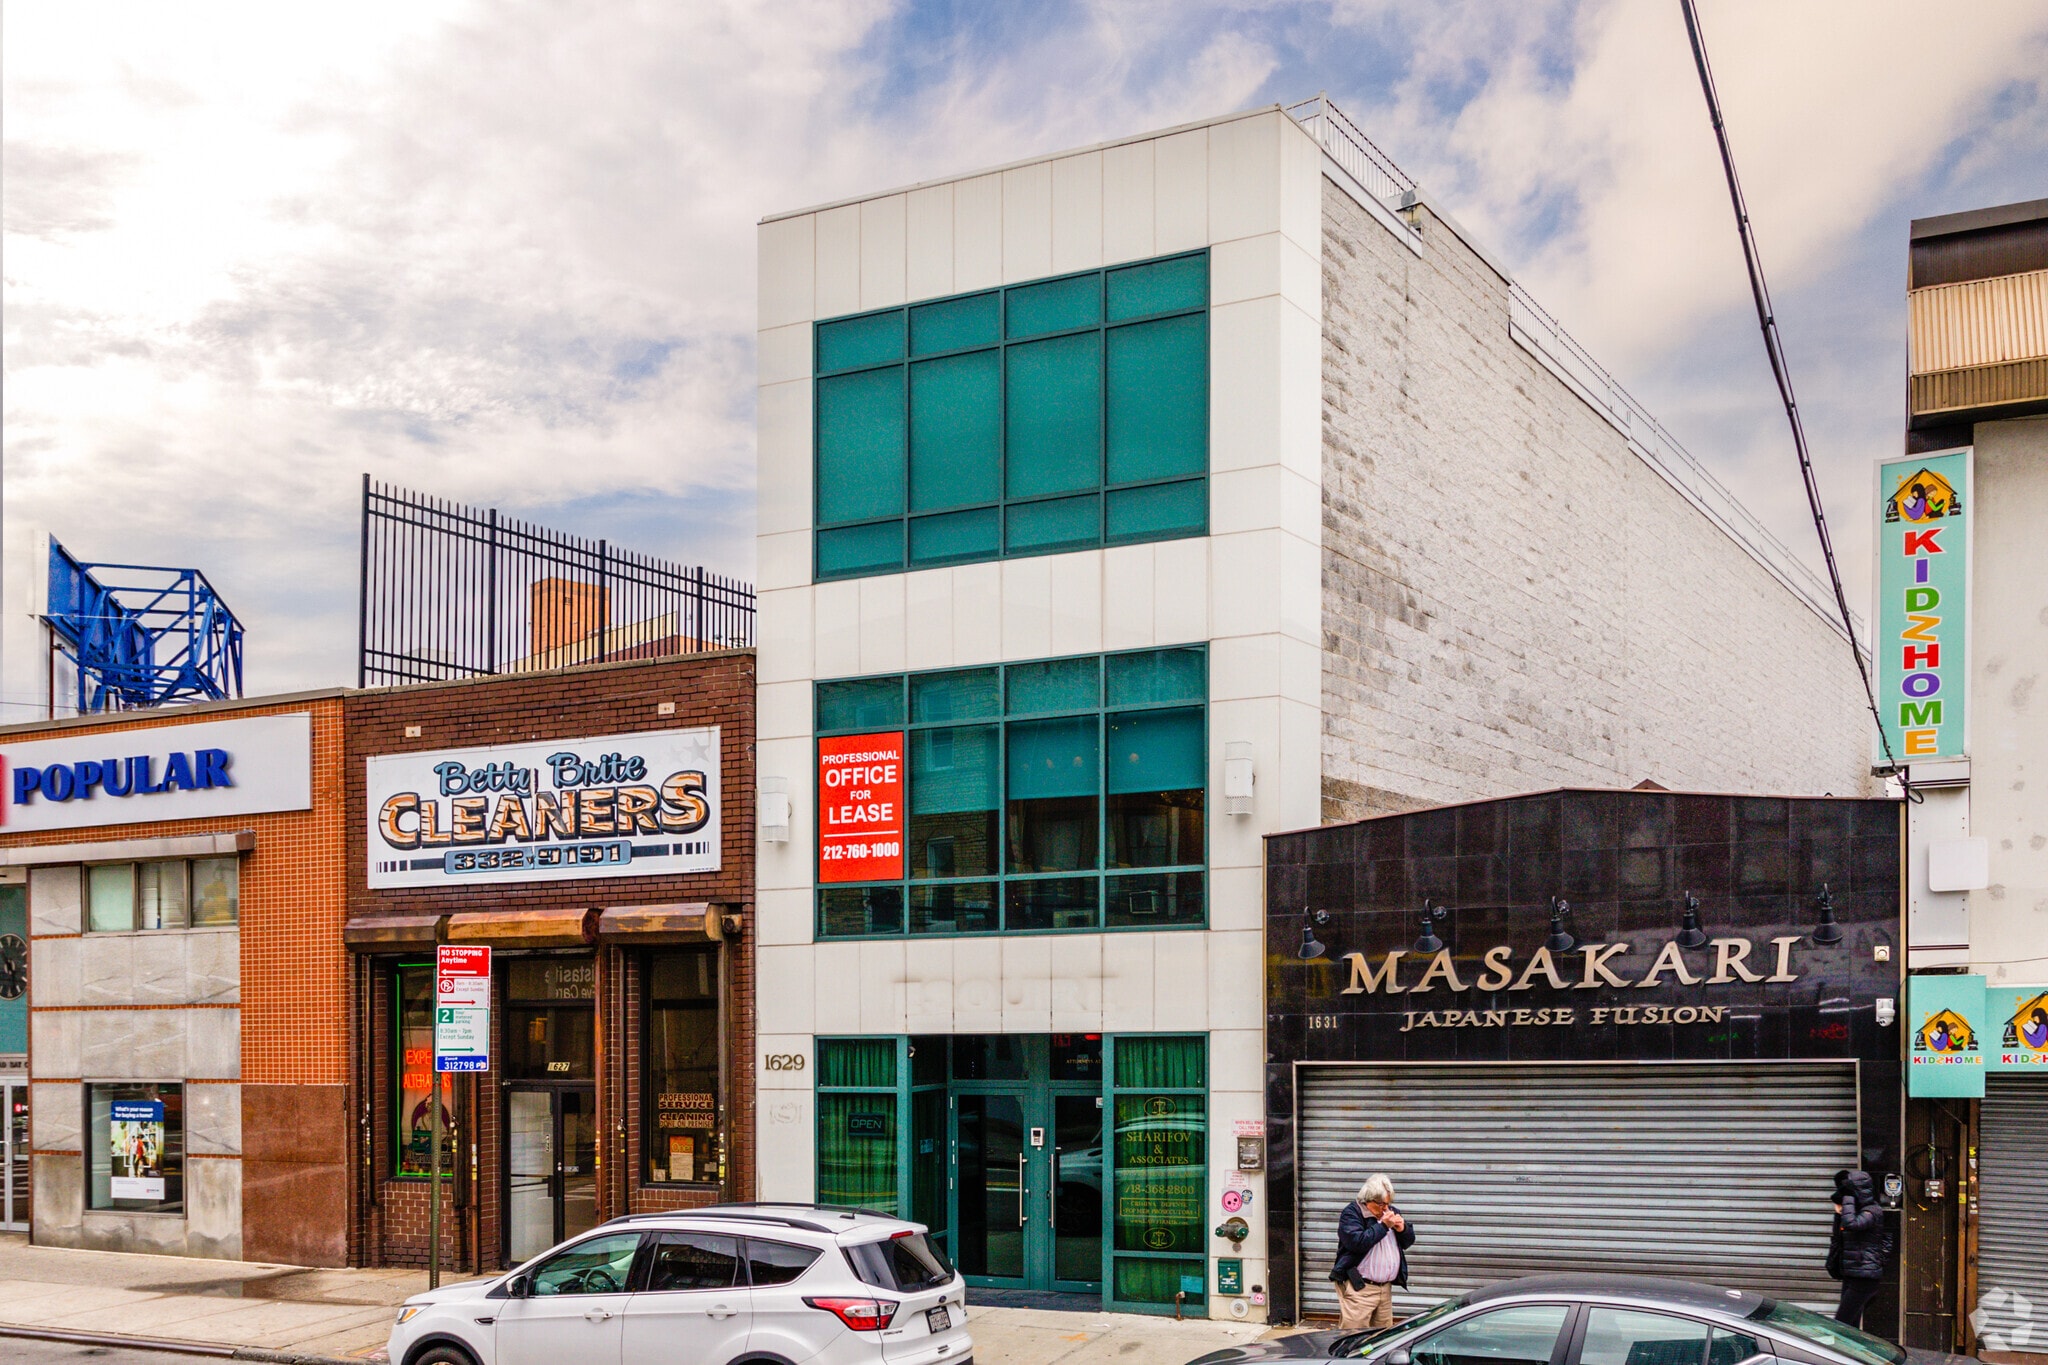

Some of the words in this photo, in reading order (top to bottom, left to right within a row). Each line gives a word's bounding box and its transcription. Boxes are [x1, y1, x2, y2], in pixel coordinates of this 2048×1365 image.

[1900, 528, 1944, 755] KIDZHOME
[822, 750, 899, 765] PROFESSIONAL
[13, 748, 233, 805] POPULAR
[434, 761, 537, 797] Betty
[546, 752, 648, 789] Brite
[825, 765, 897, 787] OFFICE
[850, 790, 871, 800] FOR
[378, 770, 710, 851] CLEANERS
[829, 803, 893, 825] LEASE
[823, 842, 899, 860] 212-760-1000
[441, 949, 450, 957] NO
[451, 949, 483, 957] STOPPING
[441, 957, 468, 965] Anytime
[1341, 935, 1802, 996] MASAKARI
[441, 1009, 450, 1022] 2
[1309, 1015, 1337, 1029] 1631
[1400, 1007, 1575, 1032] JAPANESE
[1590, 1005, 1728, 1026] FUSION
[406, 1049, 432, 1065] EXPE
[765, 1054, 805, 1071] 1629
[1913, 1056, 1982, 1065] KIDZHOME
[445, 1061, 474, 1070] 312798
[659, 1093, 713, 1102] PROFESSIONAL
[659, 1101, 713, 1109] SERVICE
[660, 1113, 713, 1121] CLEANING
[850, 1118, 882, 1129] OPEN
[1126, 1131, 1192, 1143] SHARIFOV
[1153, 1144, 1163, 1155] &
[1129, 1155, 1189, 1165] ASSOCIATES
